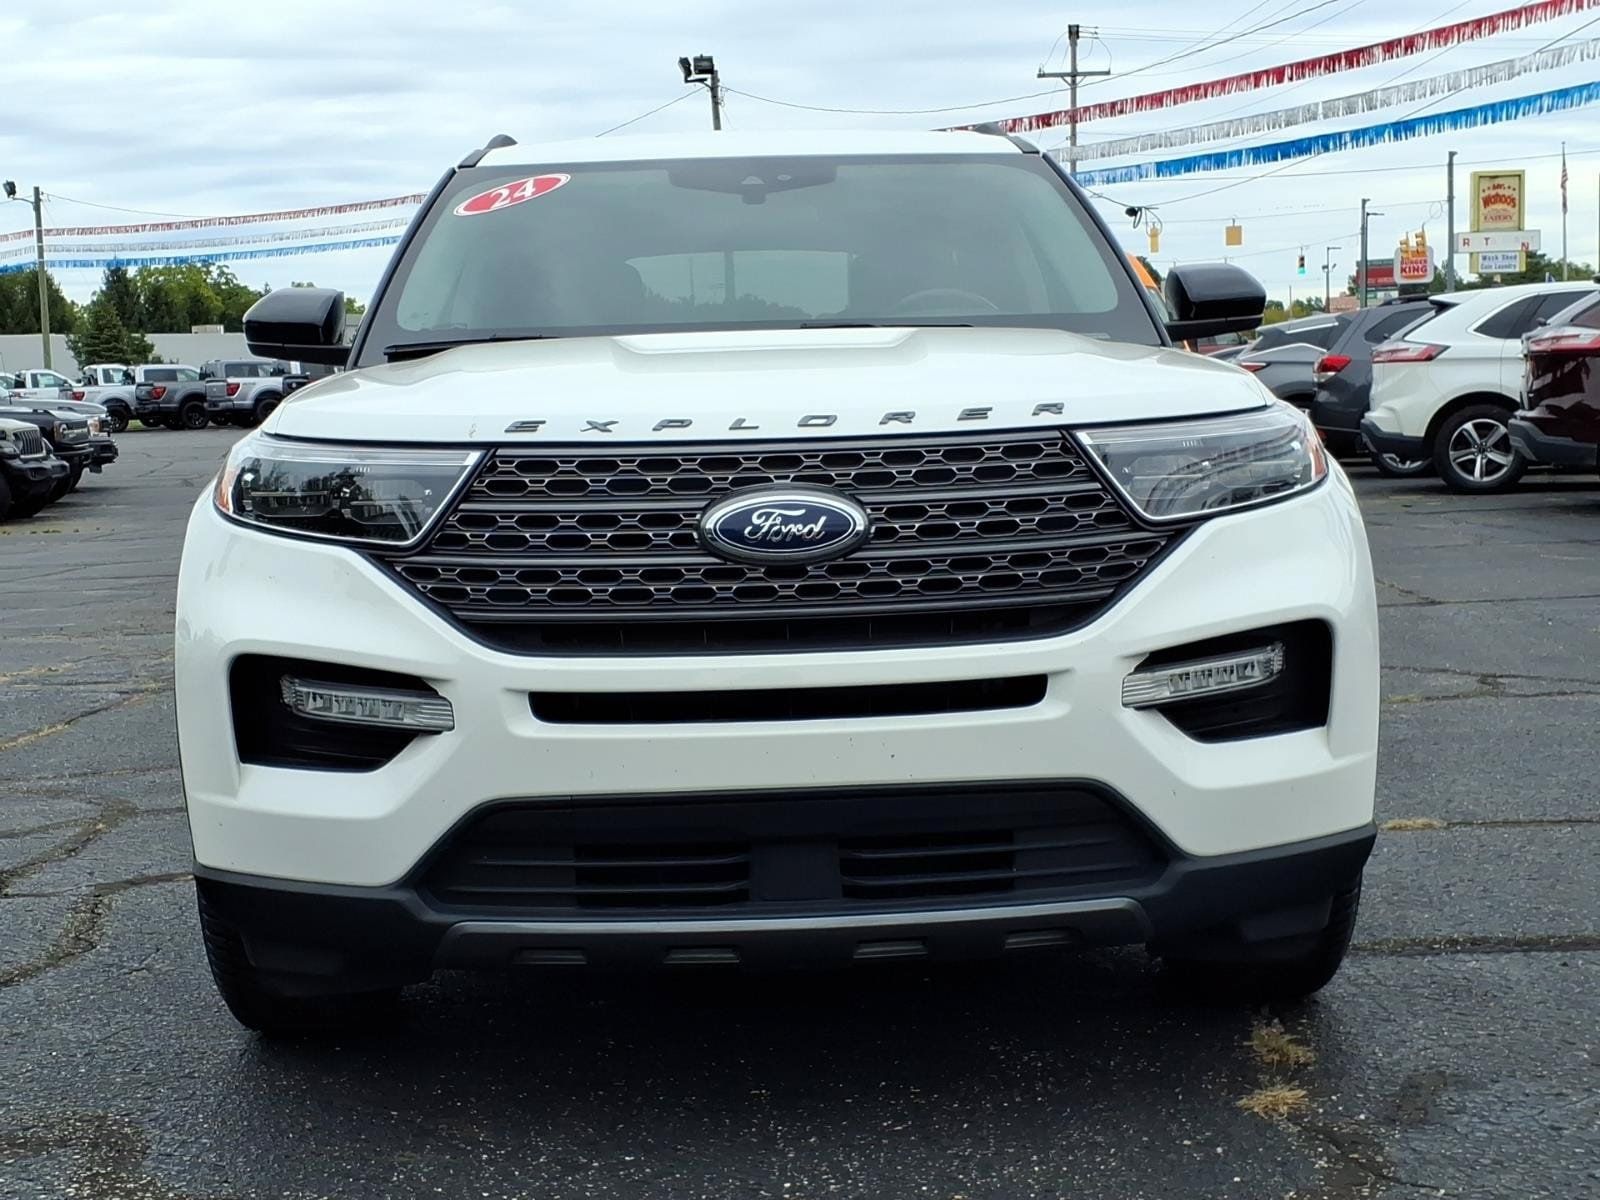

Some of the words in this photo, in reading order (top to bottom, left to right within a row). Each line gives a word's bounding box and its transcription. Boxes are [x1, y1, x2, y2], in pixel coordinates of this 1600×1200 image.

[490, 178, 536, 209] 24
[1462, 238, 1470, 247] R
[1484, 237, 1490, 246] T
[1521, 242, 1529, 251] N
[1400, 265, 1428, 274] KING
[504, 402, 1065, 433] EXPLORER
[744, 508, 827, 542] Ford
